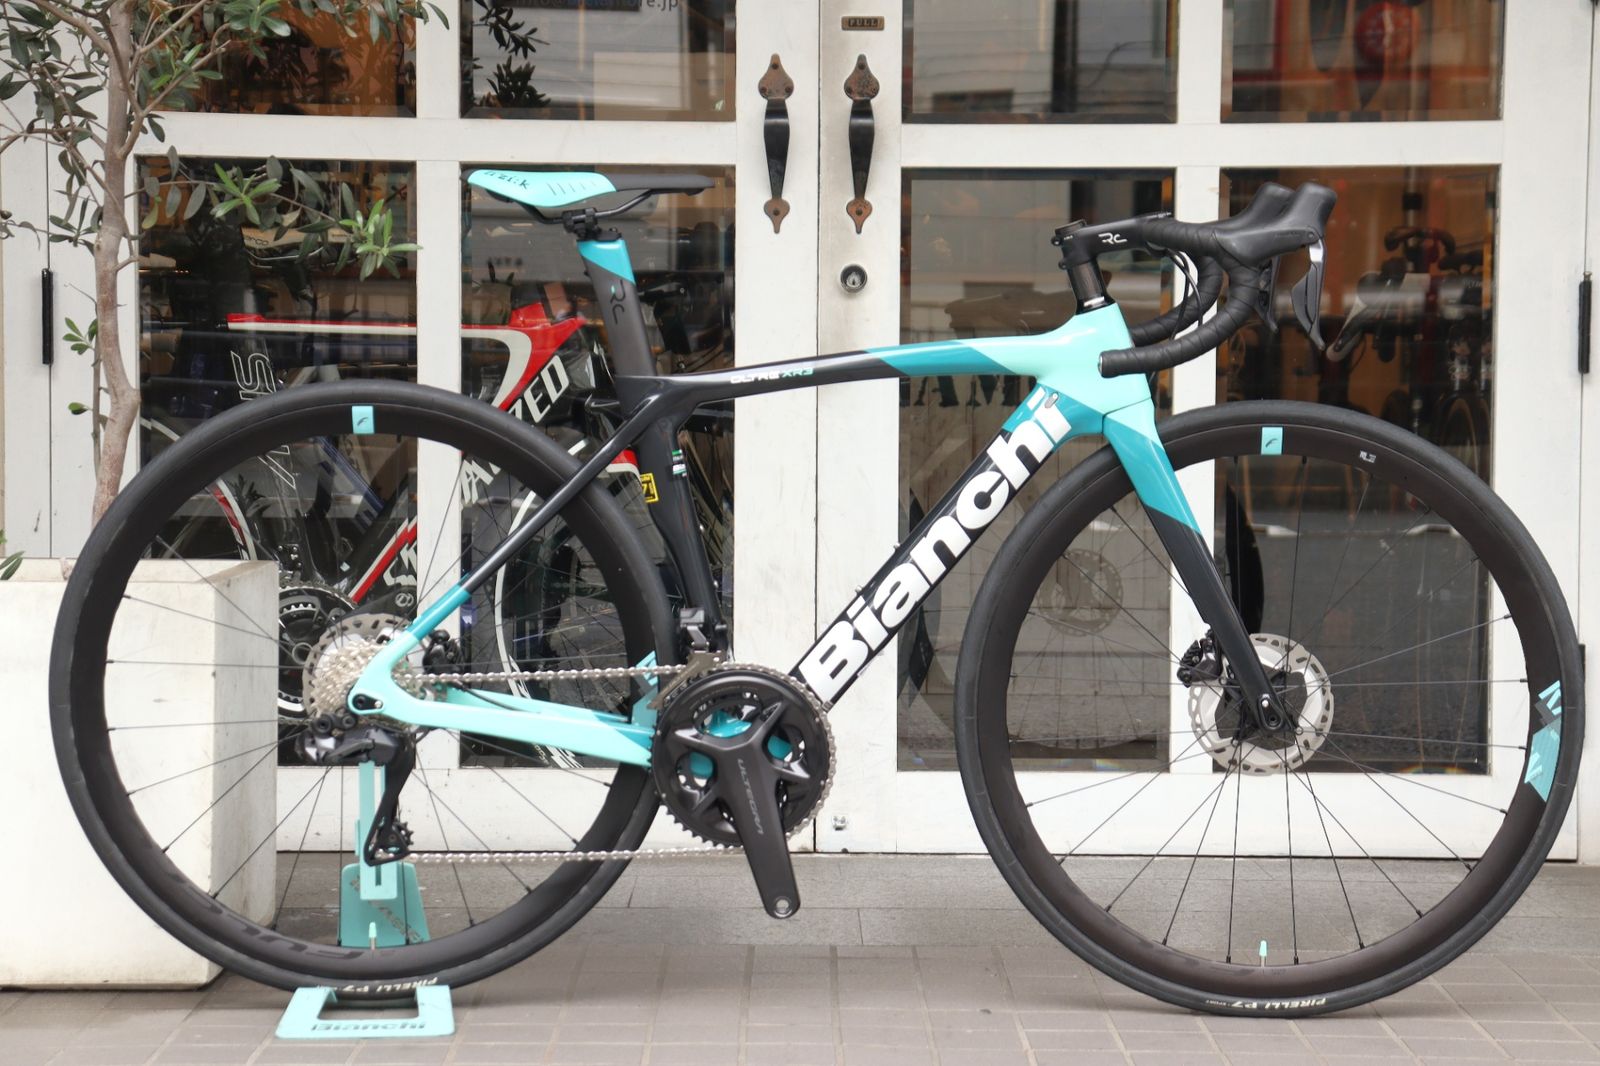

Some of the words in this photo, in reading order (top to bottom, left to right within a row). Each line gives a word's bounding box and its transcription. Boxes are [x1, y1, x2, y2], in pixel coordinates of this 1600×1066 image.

[850, 18, 877, 26] PULL
[798, 386, 1072, 705] Bianchi
[737, 757, 765, 836] ULTEGRA
[1231, 1001, 1258, 1010] P7
[1264, 997, 1327, 1011] PIRELLI
